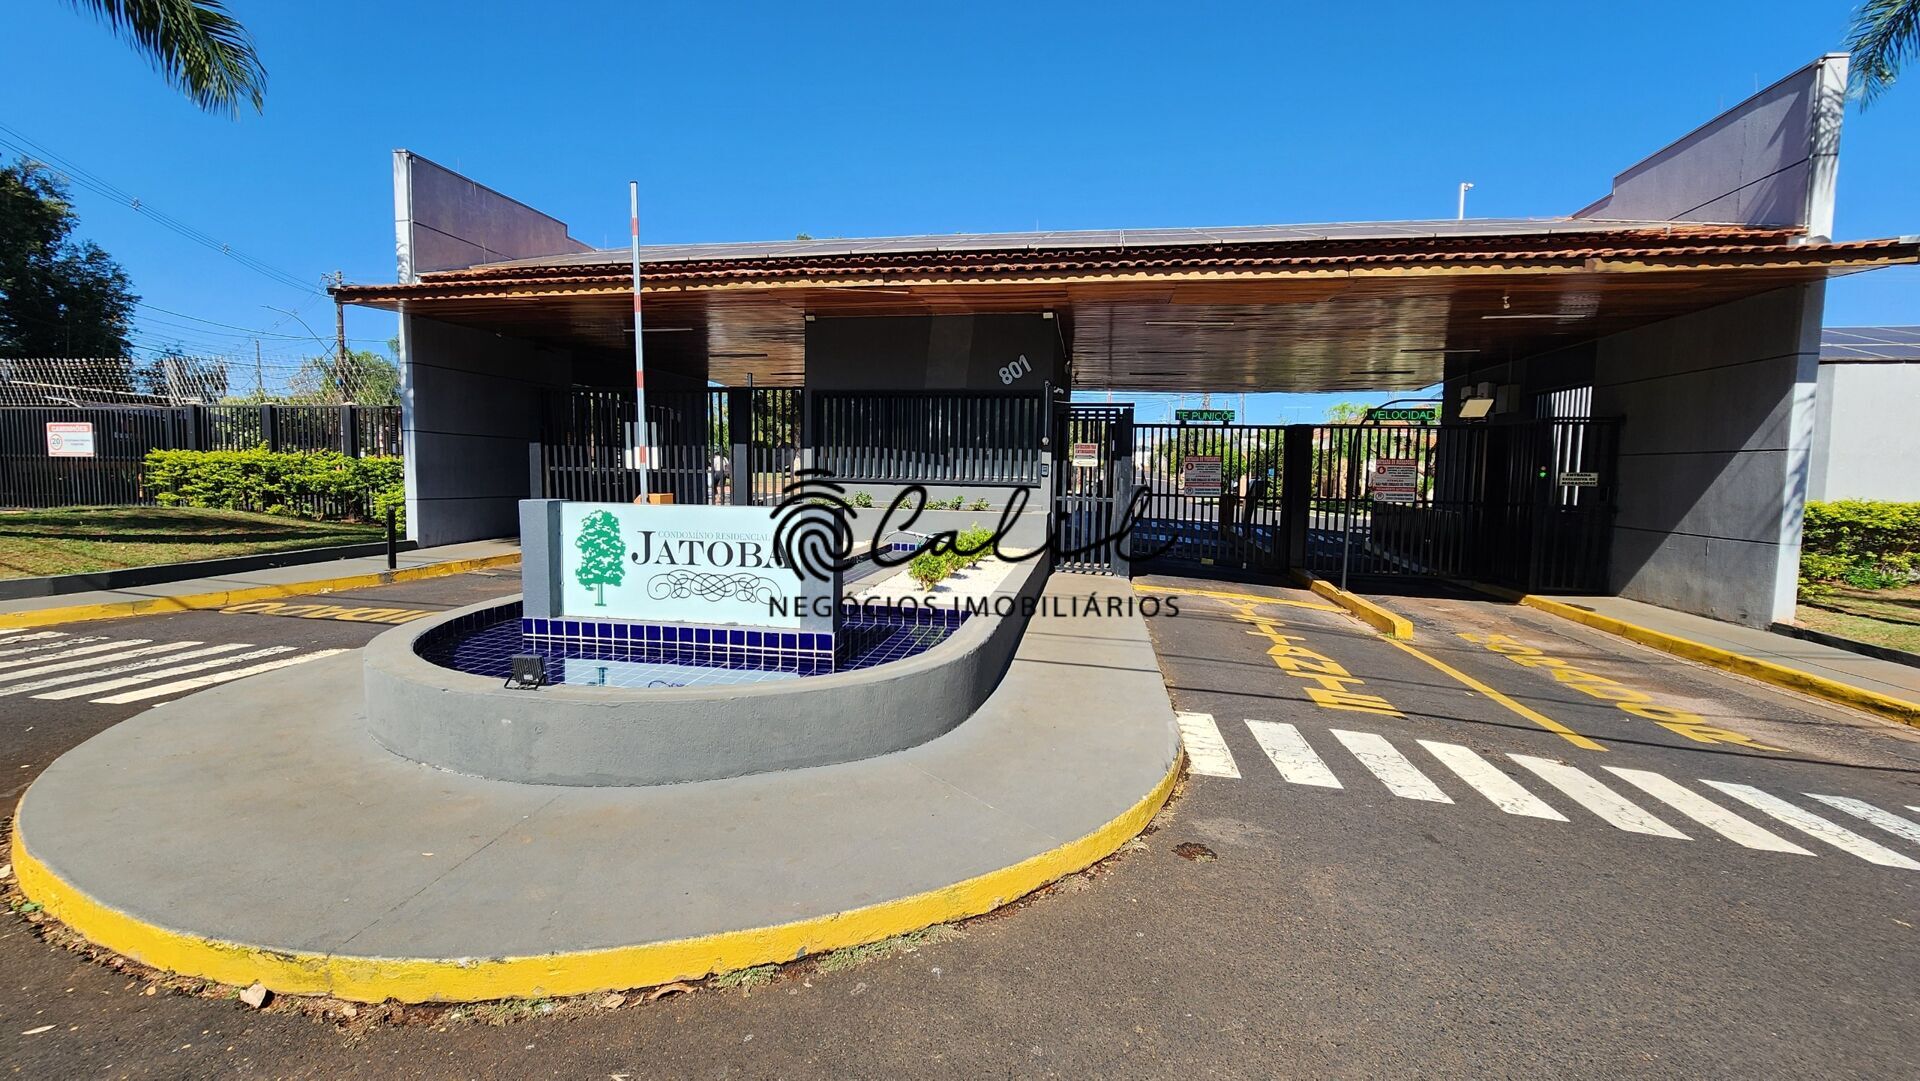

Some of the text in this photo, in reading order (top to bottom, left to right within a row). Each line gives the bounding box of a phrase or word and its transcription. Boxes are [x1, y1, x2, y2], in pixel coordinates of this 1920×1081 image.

[998, 354, 1032, 385] 801
[52, 437, 60, 445] 20
[715, 533, 770, 542] RESIDENCIAL
